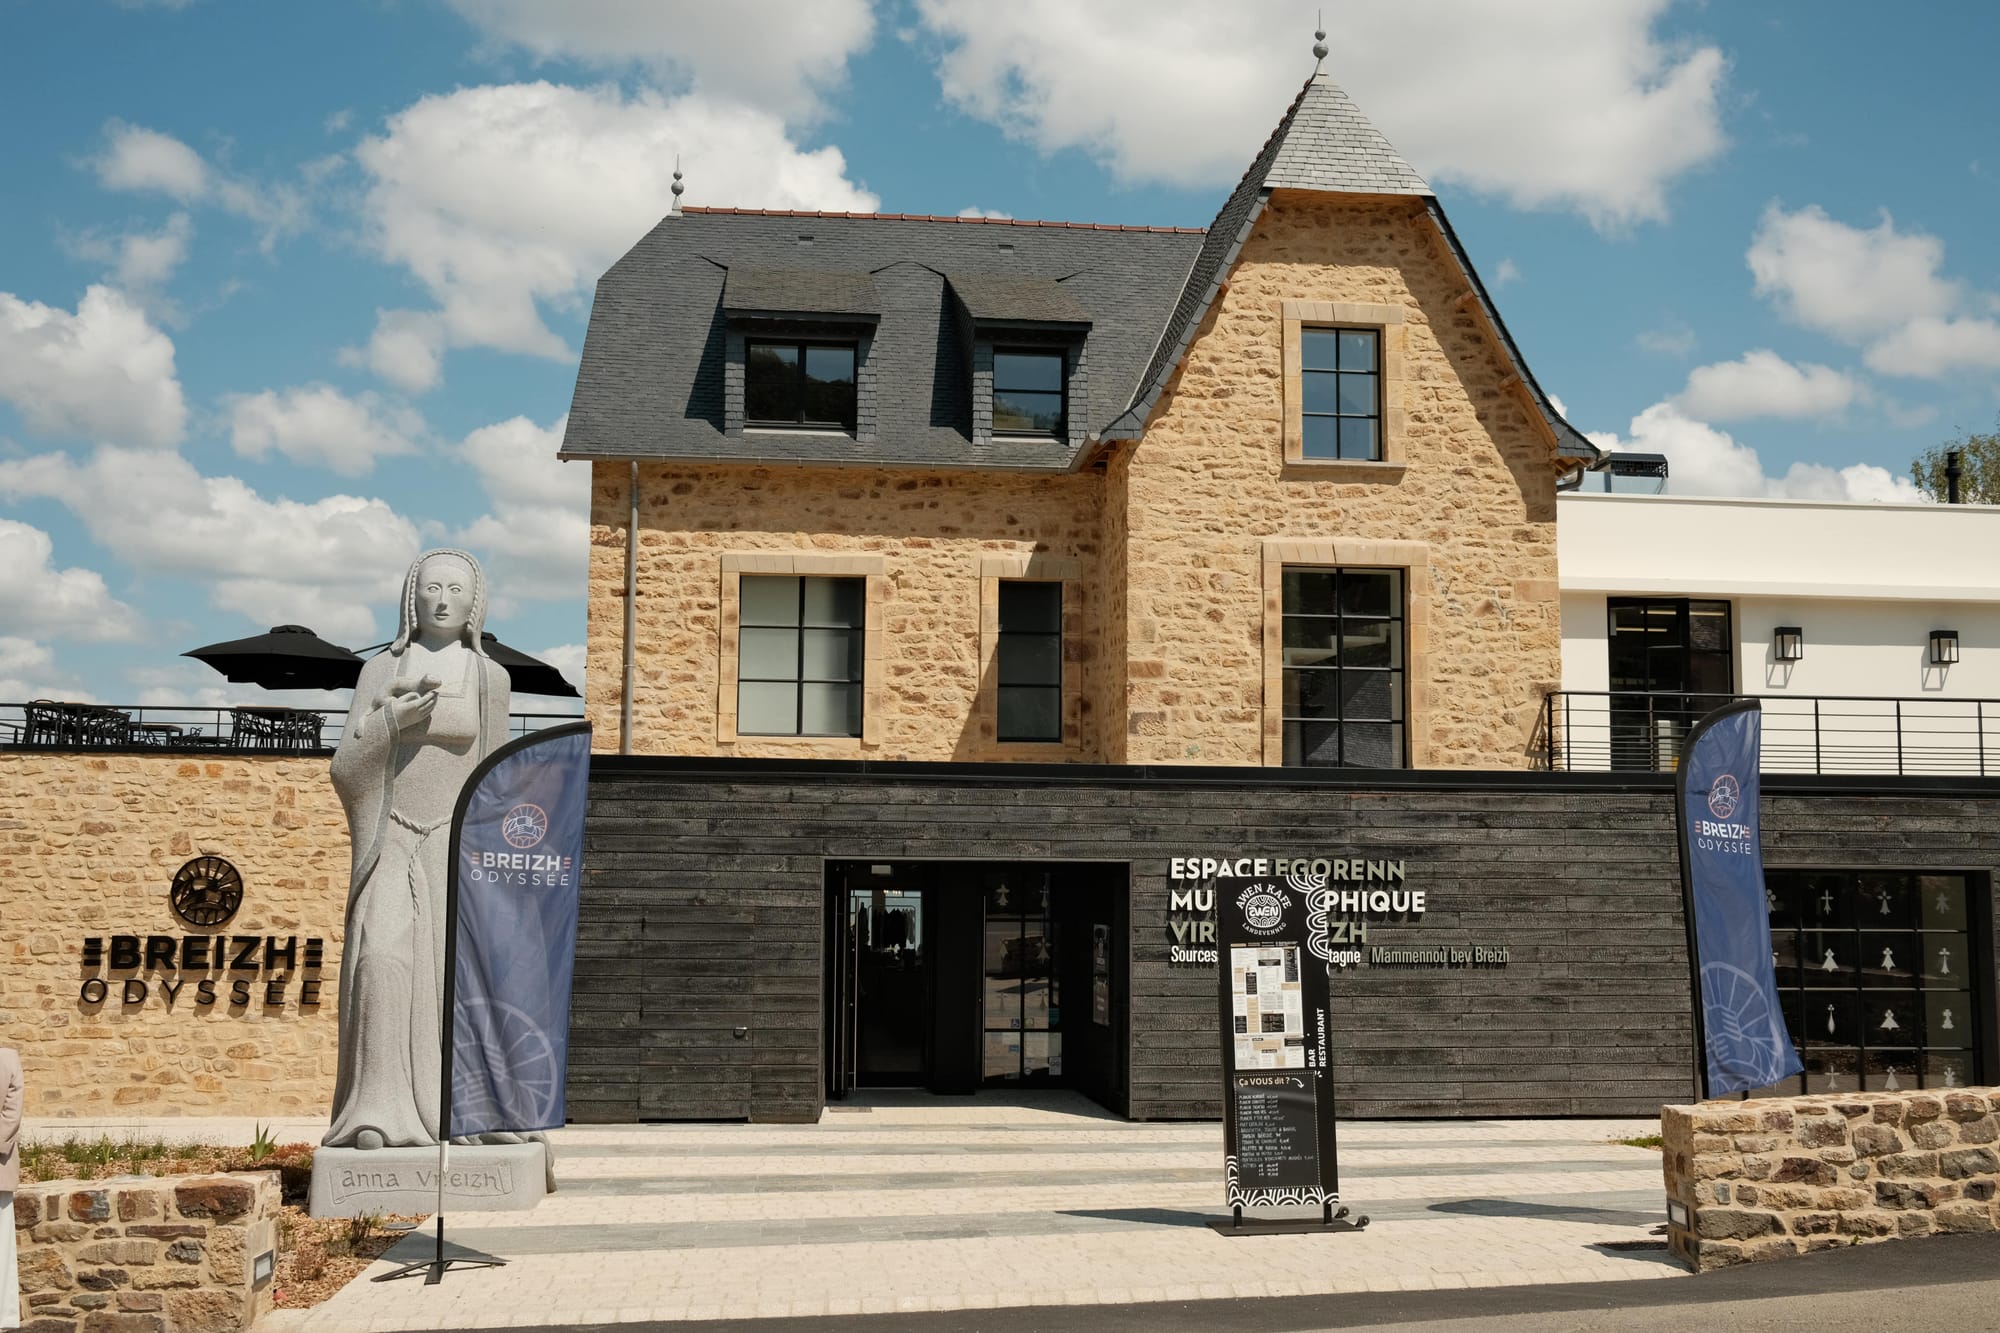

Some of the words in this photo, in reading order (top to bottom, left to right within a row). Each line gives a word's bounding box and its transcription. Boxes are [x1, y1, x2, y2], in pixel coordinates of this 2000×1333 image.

[1702, 820, 1746, 840] BREIZH
[482, 852, 561, 871] BREIZH
[1171, 857, 1267, 880] ESPACE
[1275, 859, 1405, 881] EGORENN
[470, 868, 569, 887] ODYSSÉE
[1171, 889, 1213, 911] MU
[1324, 890, 1425, 913] PHIQUE
[1236, 883, 1263, 910] AWEN
[1265, 884, 1292, 909] KAFE
[110, 935, 297, 970] BREIZH
[1171, 945, 1218, 963] Sources
[1328, 948, 1361, 967] tagne
[1371, 946, 1447, 964] Mammennoù
[1450, 946, 1472, 963] bev
[1475, 946, 1510, 963] Breizh
[80, 975, 321, 1006] ODYSSÉE
[1316, 1007, 1326, 1067] RESTAURANT
[1308, 1049, 1316, 1067] BAR
[1238, 1078, 1249, 1088] Ça
[1250, 1077, 1273, 1086] VOUS
[1274, 1076, 1284, 1085] dit
